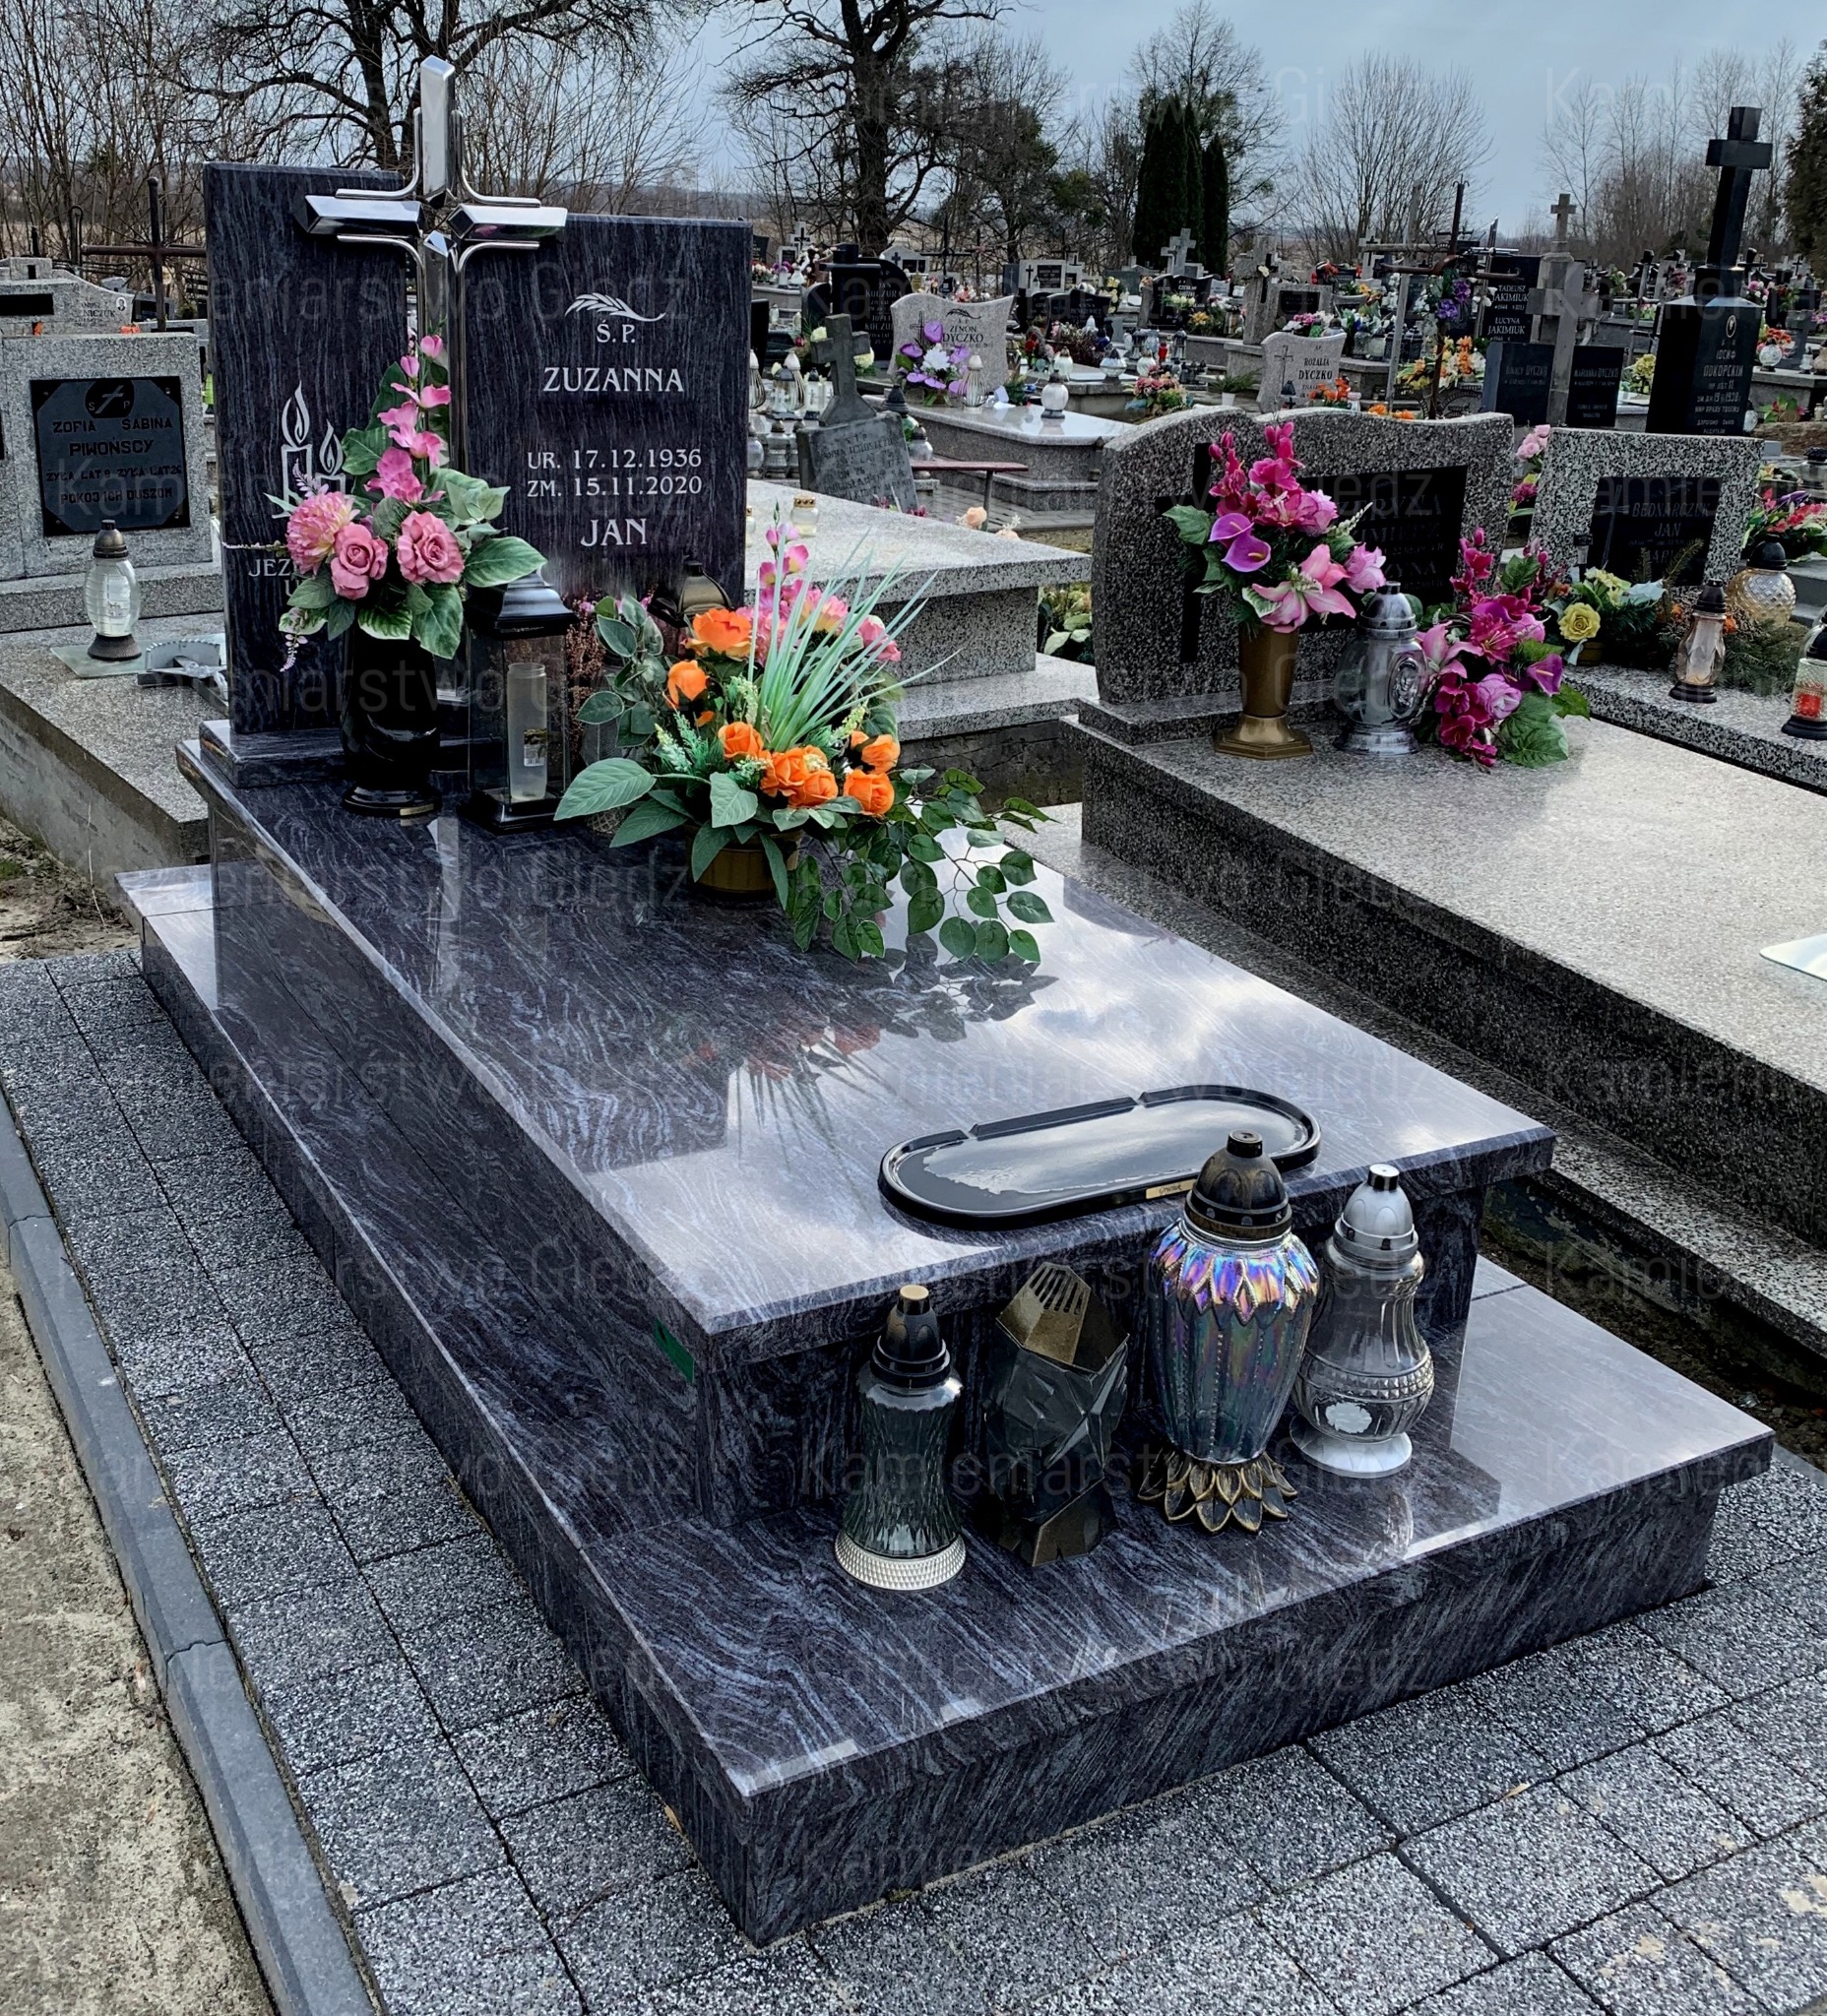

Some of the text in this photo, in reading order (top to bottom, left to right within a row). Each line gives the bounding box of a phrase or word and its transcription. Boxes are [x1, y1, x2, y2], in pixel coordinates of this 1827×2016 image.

[1491, 292, 1529, 302] JAKIMIUK
[949, 324, 977, 333] ZENON
[1494, 316, 1521, 325] LUCYNA
[596, 318, 637, 344] Ś. P.
[941, 332, 984, 344] DYCZKO
[1487, 325, 1526, 336] JAKIMIUK
[1303, 357, 1330, 366] ROZALIA
[541, 366, 685, 394] ZUZANNA
[1298, 369, 1333, 380] DYCZKO
[52, 416, 173, 434] ZOFIA SABINA
[69, 435, 155, 457] PIWOŃSCY
[527, 448, 703, 471] UR. 17.12.1936
[527, 474, 704, 498] ZM. 15.11.2020
[1630, 502, 1713, 519] BEDNARCZUK
[580, 517, 649, 547] JAN
[1654, 522, 1682, 537] JAN
[248, 558, 297, 577] JEZ
